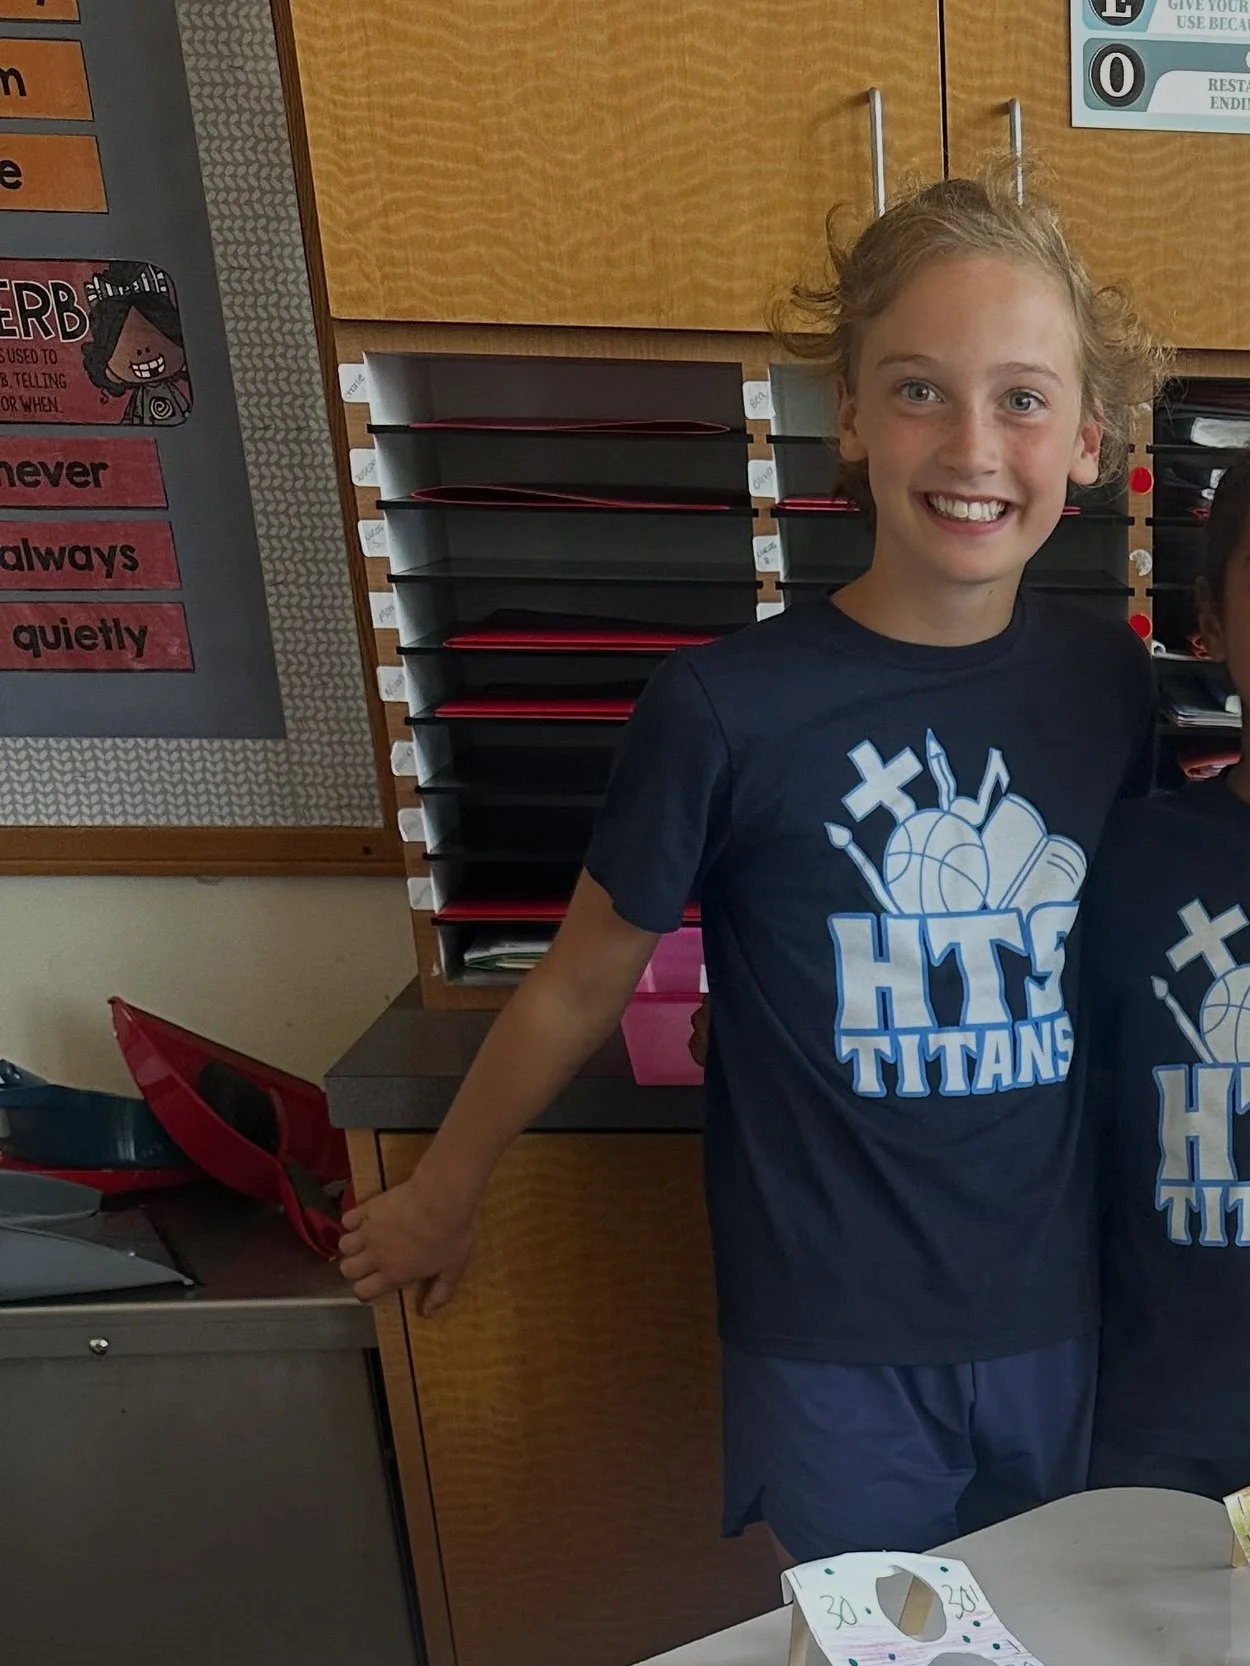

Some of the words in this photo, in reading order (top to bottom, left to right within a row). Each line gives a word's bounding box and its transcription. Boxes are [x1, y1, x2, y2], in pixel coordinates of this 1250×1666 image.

[1168, 0, 1206, 11] GIVE
[1208, 0, 1249, 13] YOUR
[1176, 15, 1205, 29] USE
[1099, 52, 1135, 97] O
[8, 349, 39, 364] USED
[43, 350, 58, 365] TO
[15, 374, 67, 389] TELLING
[19, 397, 63, 413] WHEN.
[0, 537, 140, 579] always
[12, 616, 148, 658] quietly
[827, 899, 1081, 1032] HTS
[835, 1013, 1075, 1098] TITANS
[820, 1594, 858, 1630] 30
[940, 1583, 976, 1619] 30
